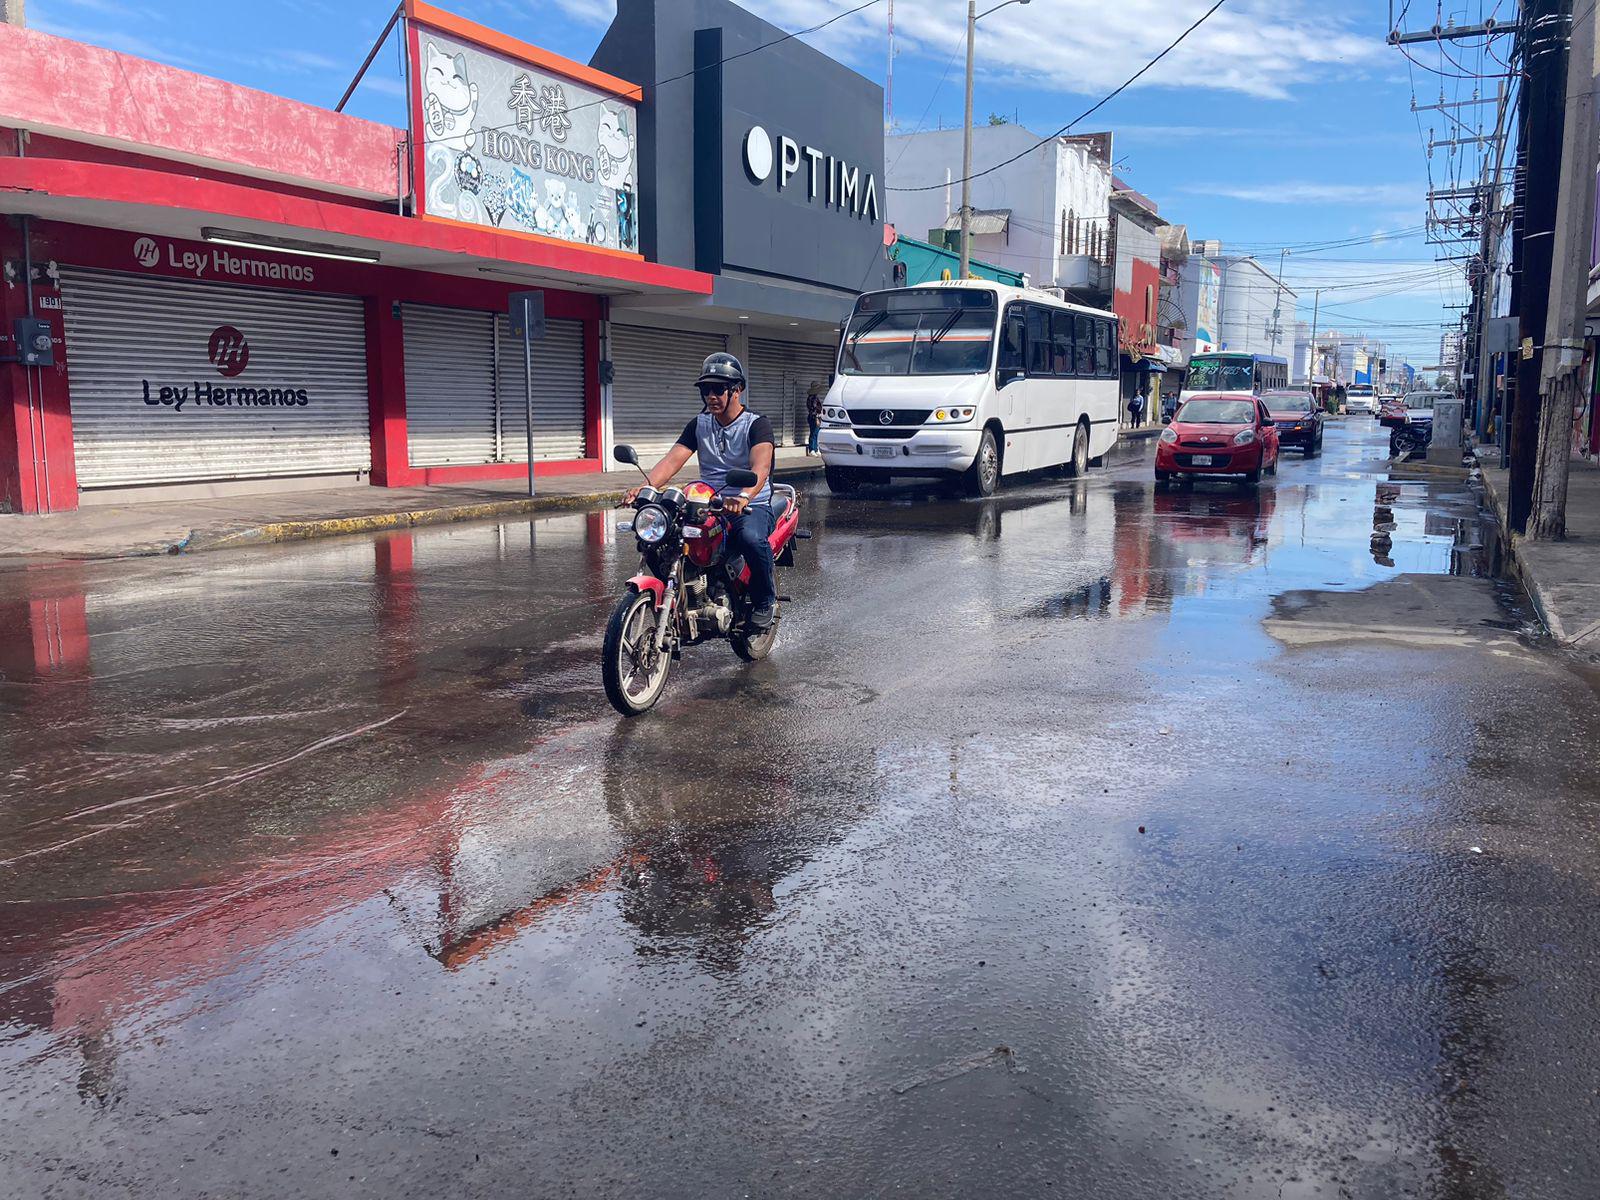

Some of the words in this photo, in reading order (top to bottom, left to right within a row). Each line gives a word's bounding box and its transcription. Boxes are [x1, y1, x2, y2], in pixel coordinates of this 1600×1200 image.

[507, 74, 572, 143] 香港
[482, 126, 542, 170] HONG
[544, 144, 596, 183] KONG
[744, 125, 880, 222] OPTIMA
[168, 243, 208, 277] Ley
[213, 250, 314, 282] Hermanos
[142, 379, 188, 412] Ley
[194, 381, 308, 406] Hermanos
